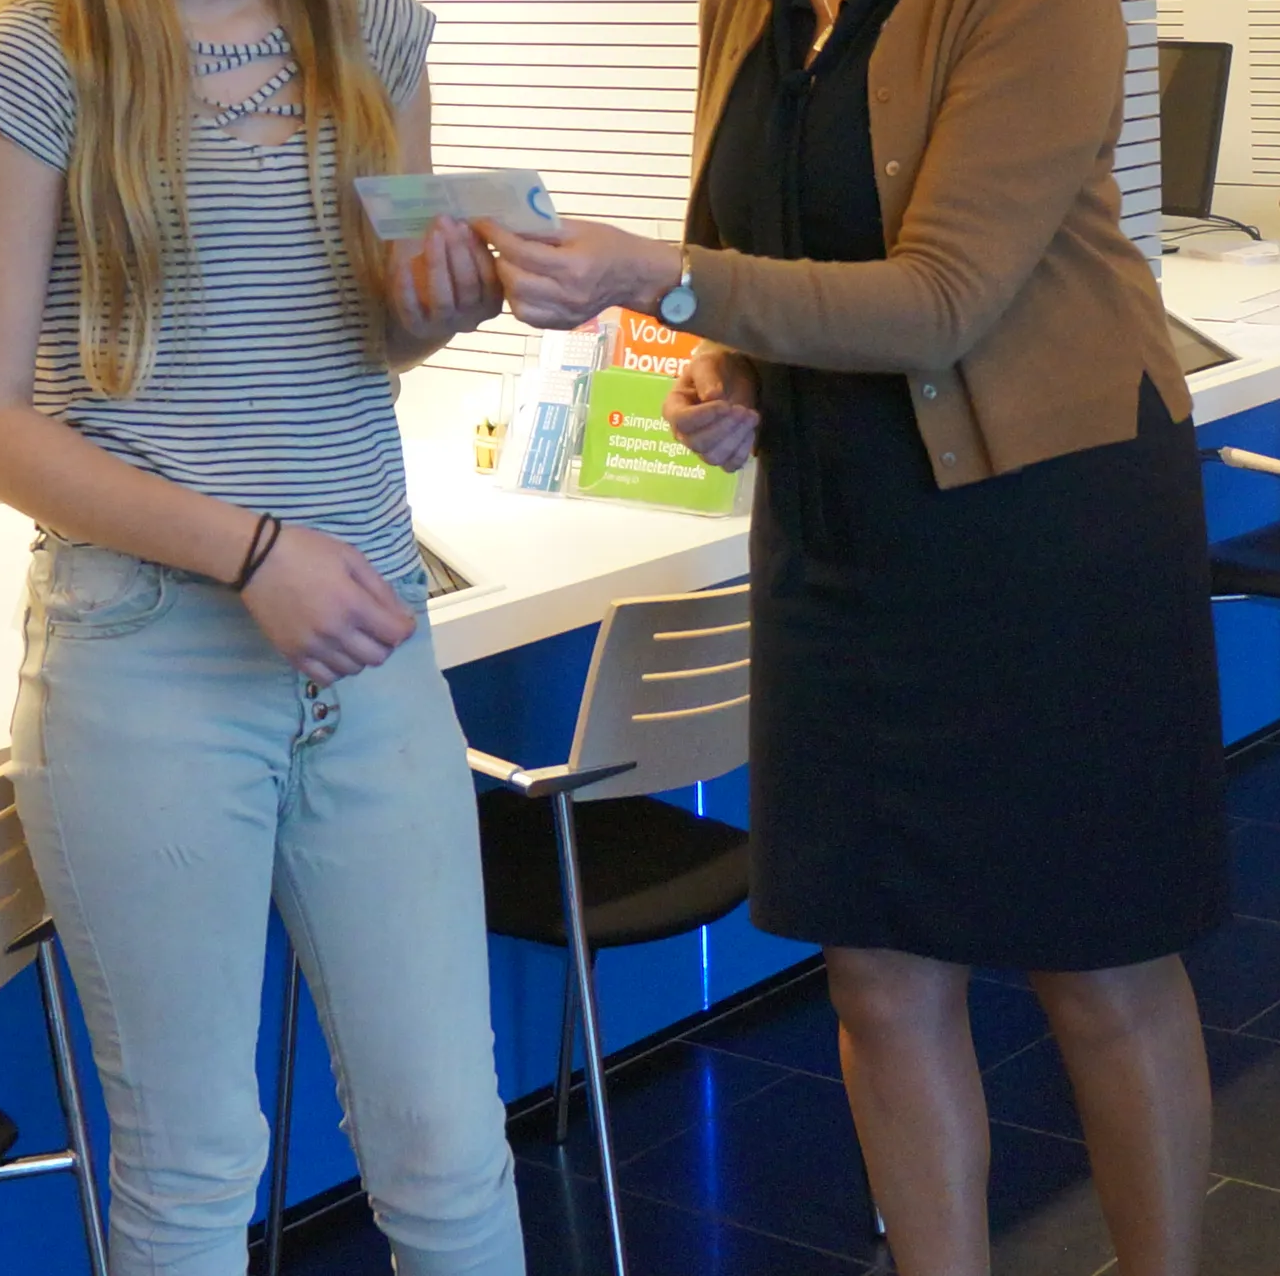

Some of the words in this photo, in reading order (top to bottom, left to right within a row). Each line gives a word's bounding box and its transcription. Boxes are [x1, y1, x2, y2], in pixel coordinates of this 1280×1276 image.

[611, 413, 620, 425] 3
[623, 413, 671, 432] simpele
[608, 433, 657, 452] stappen
